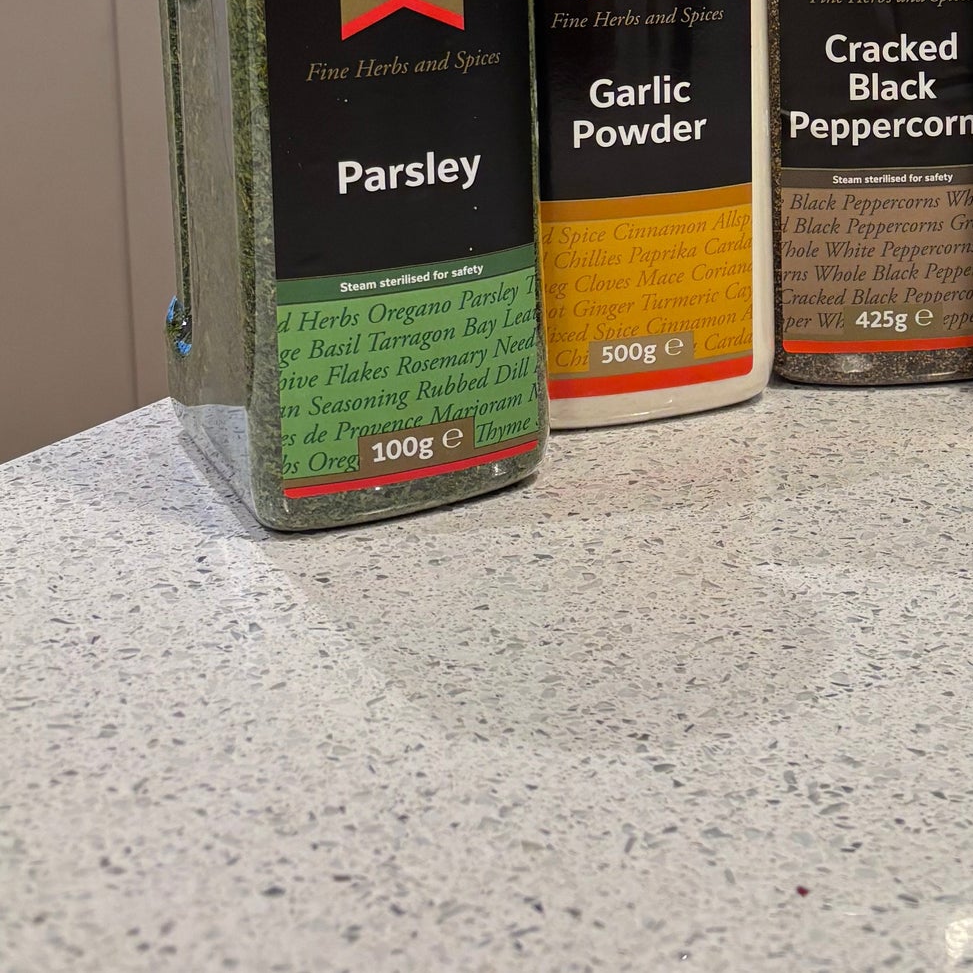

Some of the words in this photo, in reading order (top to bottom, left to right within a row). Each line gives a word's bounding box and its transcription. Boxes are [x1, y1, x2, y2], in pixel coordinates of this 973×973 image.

[551, 12, 588, 29] Fine
[593, 10, 640, 27] Herbs
[645, 7, 677, 25] and
[680, 6, 724, 27] Spices
[825, 32, 957, 63] Cracked
[306, 63, 349, 81] Fine
[355, 56, 409, 78] Herbs
[415, 52, 451, 72] and
[455, 50, 500, 70] Spices
[589, 75, 691, 108] Garlic
[849, 72, 937, 101] Black
[573, 114, 706, 149] Powder
[338, 152, 481, 194] Parsley
[833, 175, 862, 184] Steam
[865, 174, 907, 184] sterilised
[909, 174, 923, 183] for
[925, 173, 953, 183] safety
[790, 193, 836, 211] Black
[842, 194, 940, 216] Peppercorns
[559, 227, 605, 249] Spice
[613, 219, 706, 239] Cinnamon
[794, 218, 840, 235] Black
[846, 218, 944, 239] Peppercorns
[554, 250, 622, 270] Chillies
[628, 242, 696, 267] Paprika
[825, 241, 876, 258] White
[340, 280, 376, 292] Steam
[380, 272, 430, 287] sterilised
[433, 270, 449, 280] for
[452, 264, 483, 278] safety
[574, 275, 631, 297] Cloves
[636, 270, 685, 288] Mace
[814, 265, 866, 282] Whole
[872, 264, 919, 281] Black
[300, 307, 359, 332] Herbs
[368, 300, 452, 325] Oregano
[459, 284, 518, 311] Parsley
[573, 300, 635, 321] Ginger
[641, 289, 719, 311] Turmeric
[782, 289, 845, 306] Cracked
[851, 288, 898, 306] Black
[855, 310, 907, 332] 425g
[308, 335, 361, 360] Basil
[368, 325, 455, 352] Tarragon
[464, 315, 497, 338] Bay
[325, 361, 389, 386] Flakes
[397, 345, 487, 376] Rosemary
[601, 342, 657, 364] 500g
[308, 388, 410, 417] Seasoning
[417, 370, 489, 399] Rubbed
[495, 358, 529, 384] Dill
[303, 426, 326, 446] de
[336, 412, 422, 441] Provence
[430, 392, 523, 423] Marjoram
[476, 415, 530, 443] Thyme
[371, 437, 434, 463] 100g
